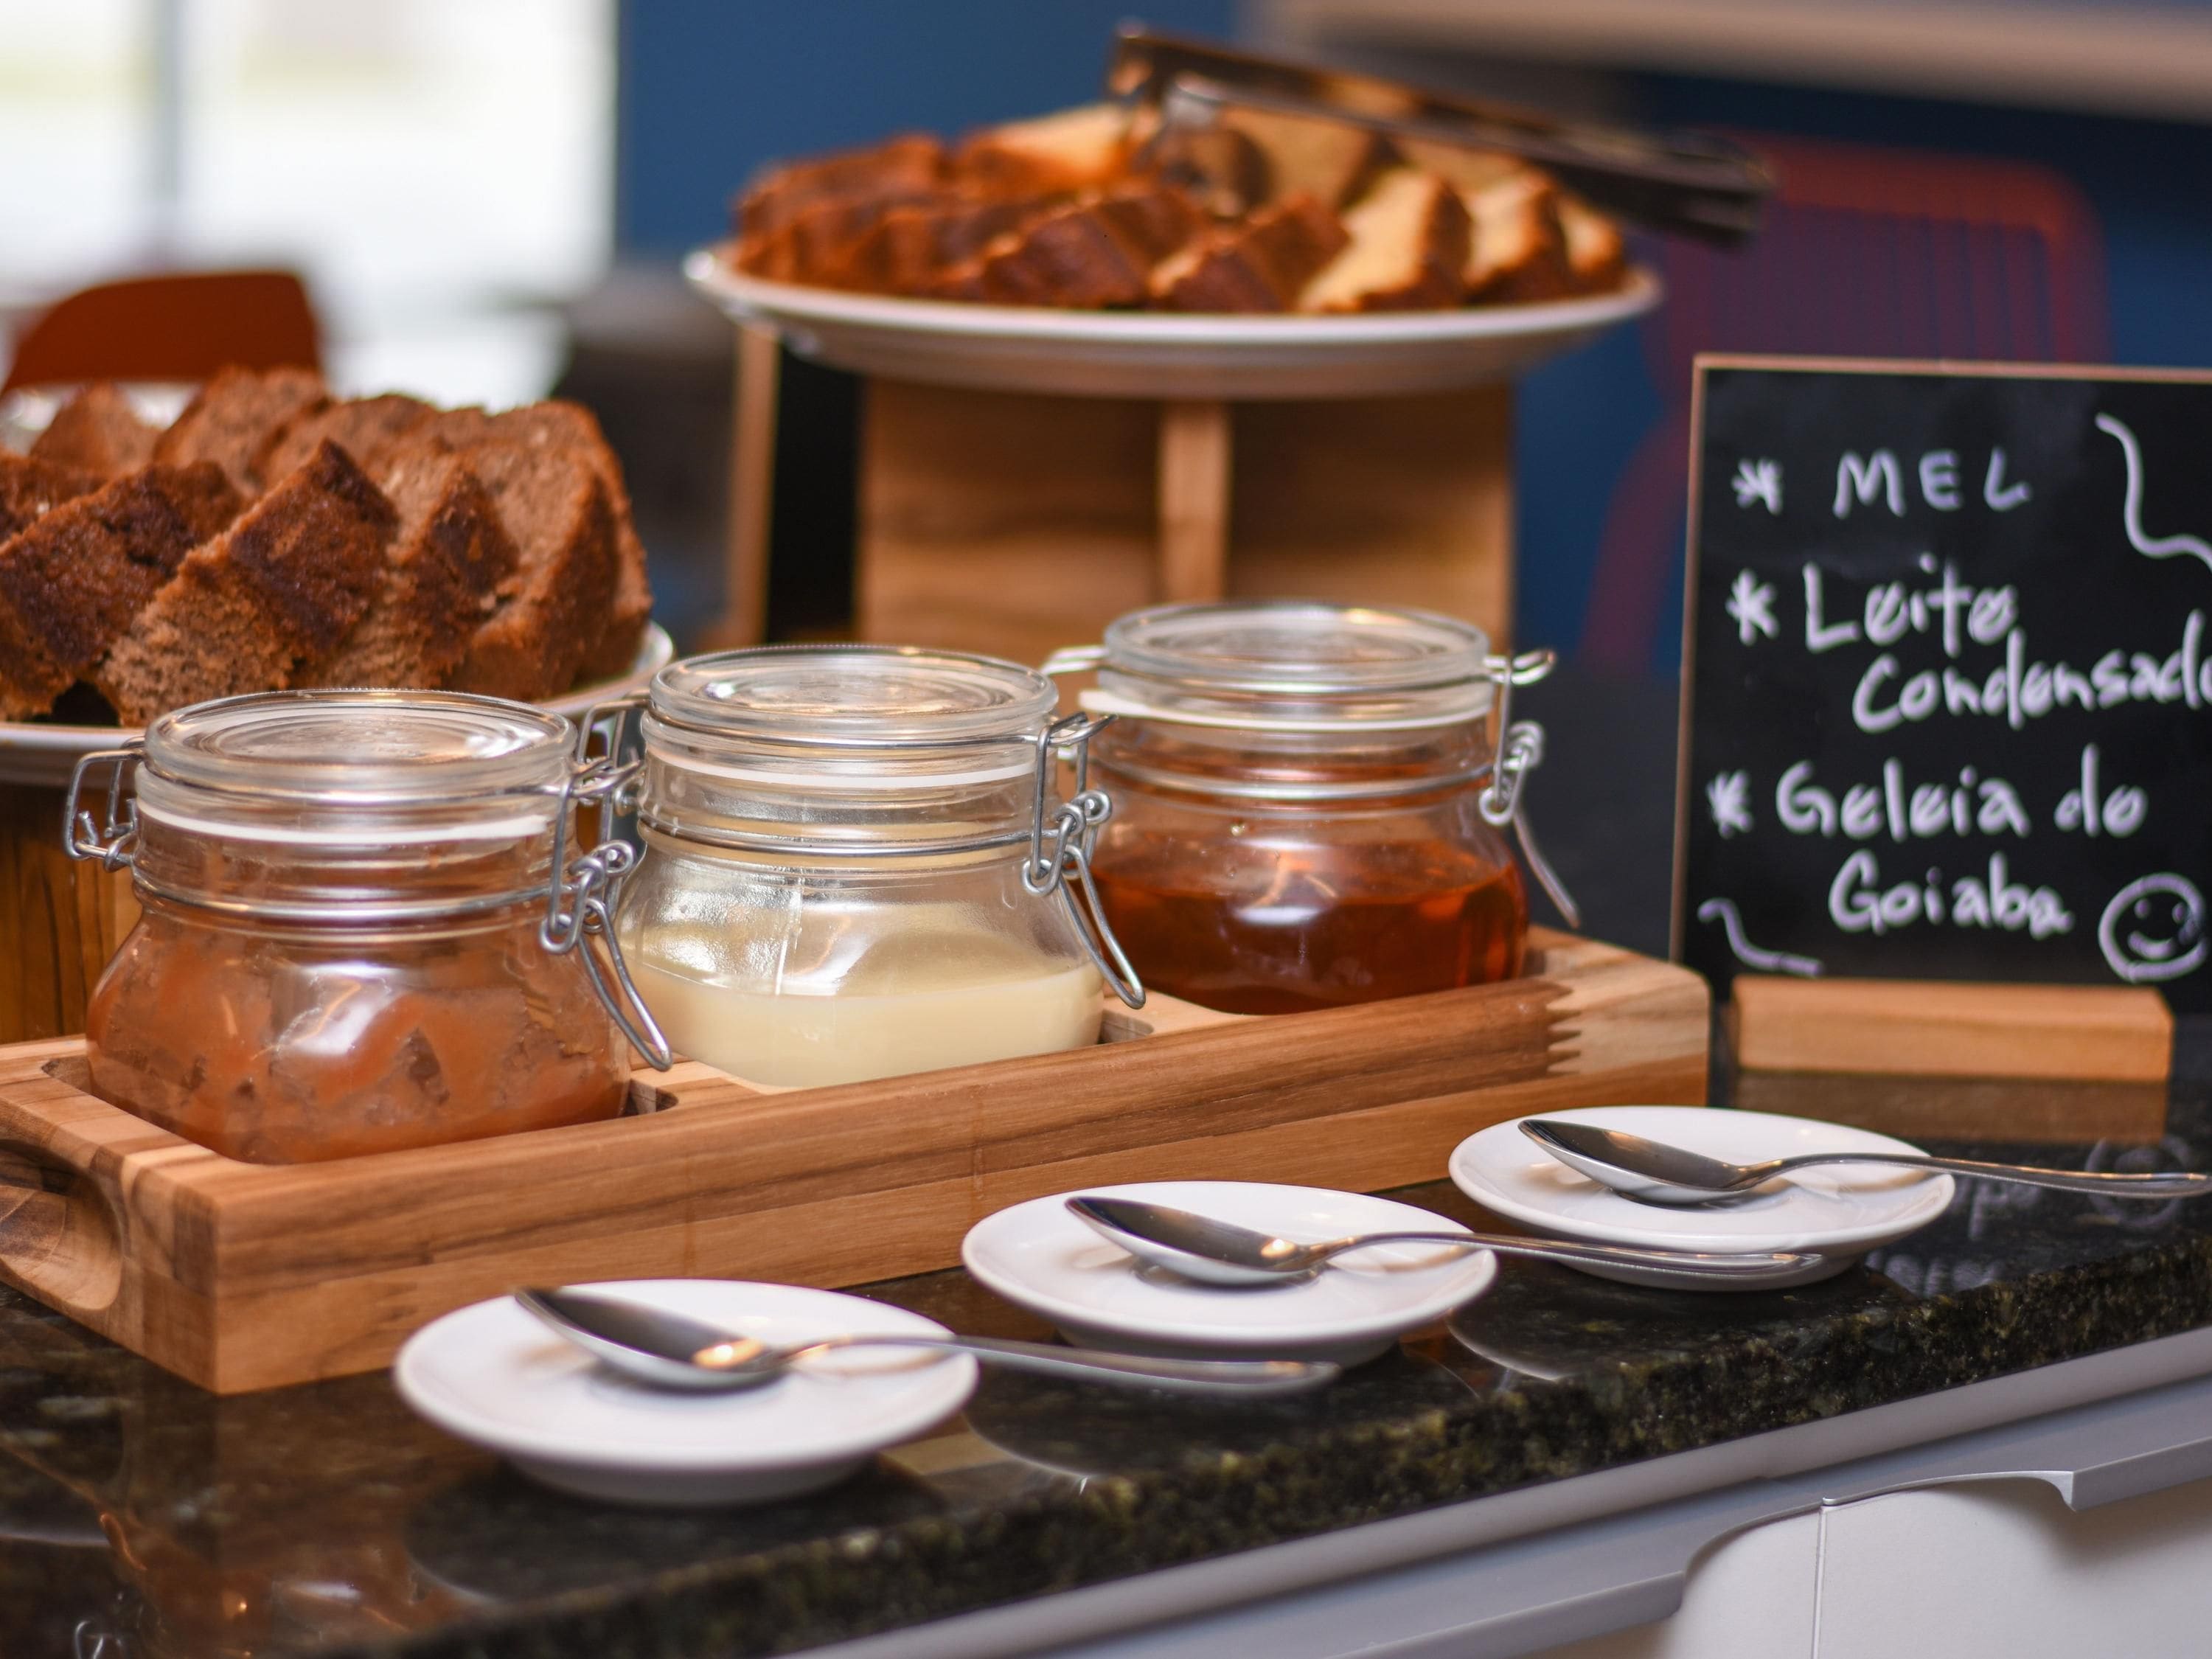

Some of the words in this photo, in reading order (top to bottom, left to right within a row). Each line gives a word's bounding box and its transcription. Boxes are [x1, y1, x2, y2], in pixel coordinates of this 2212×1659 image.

[1832, 448, 2031, 518] MEL
[1801, 552, 2019, 657] Leite
[1775, 758, 2031, 841] Geleia
[2054, 744, 2147, 837] de
[1828, 849, 2075, 941] Goiaba
